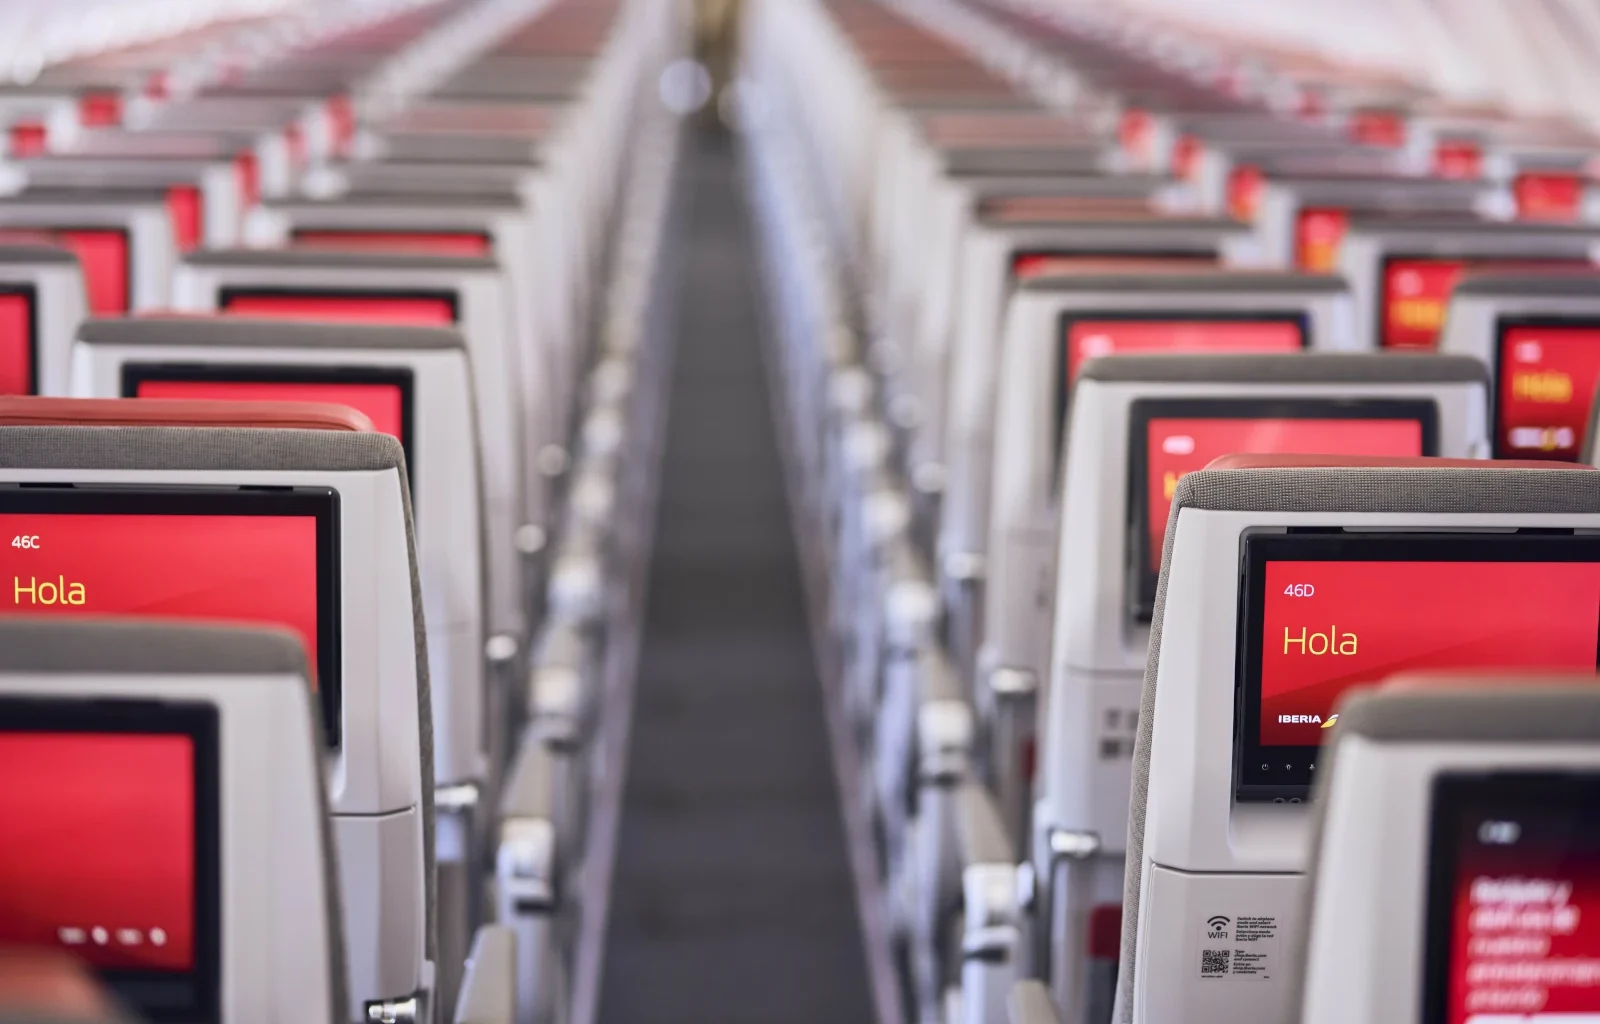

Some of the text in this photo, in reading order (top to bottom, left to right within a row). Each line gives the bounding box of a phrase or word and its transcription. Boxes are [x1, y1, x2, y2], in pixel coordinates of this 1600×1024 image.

[11, 535, 40, 549] 46C
[14, 574, 86, 605] Hola
[1283, 584, 1315, 597] 46D
[1283, 625, 1358, 655] Hola
[1278, 714, 1321, 724] IBERIA
